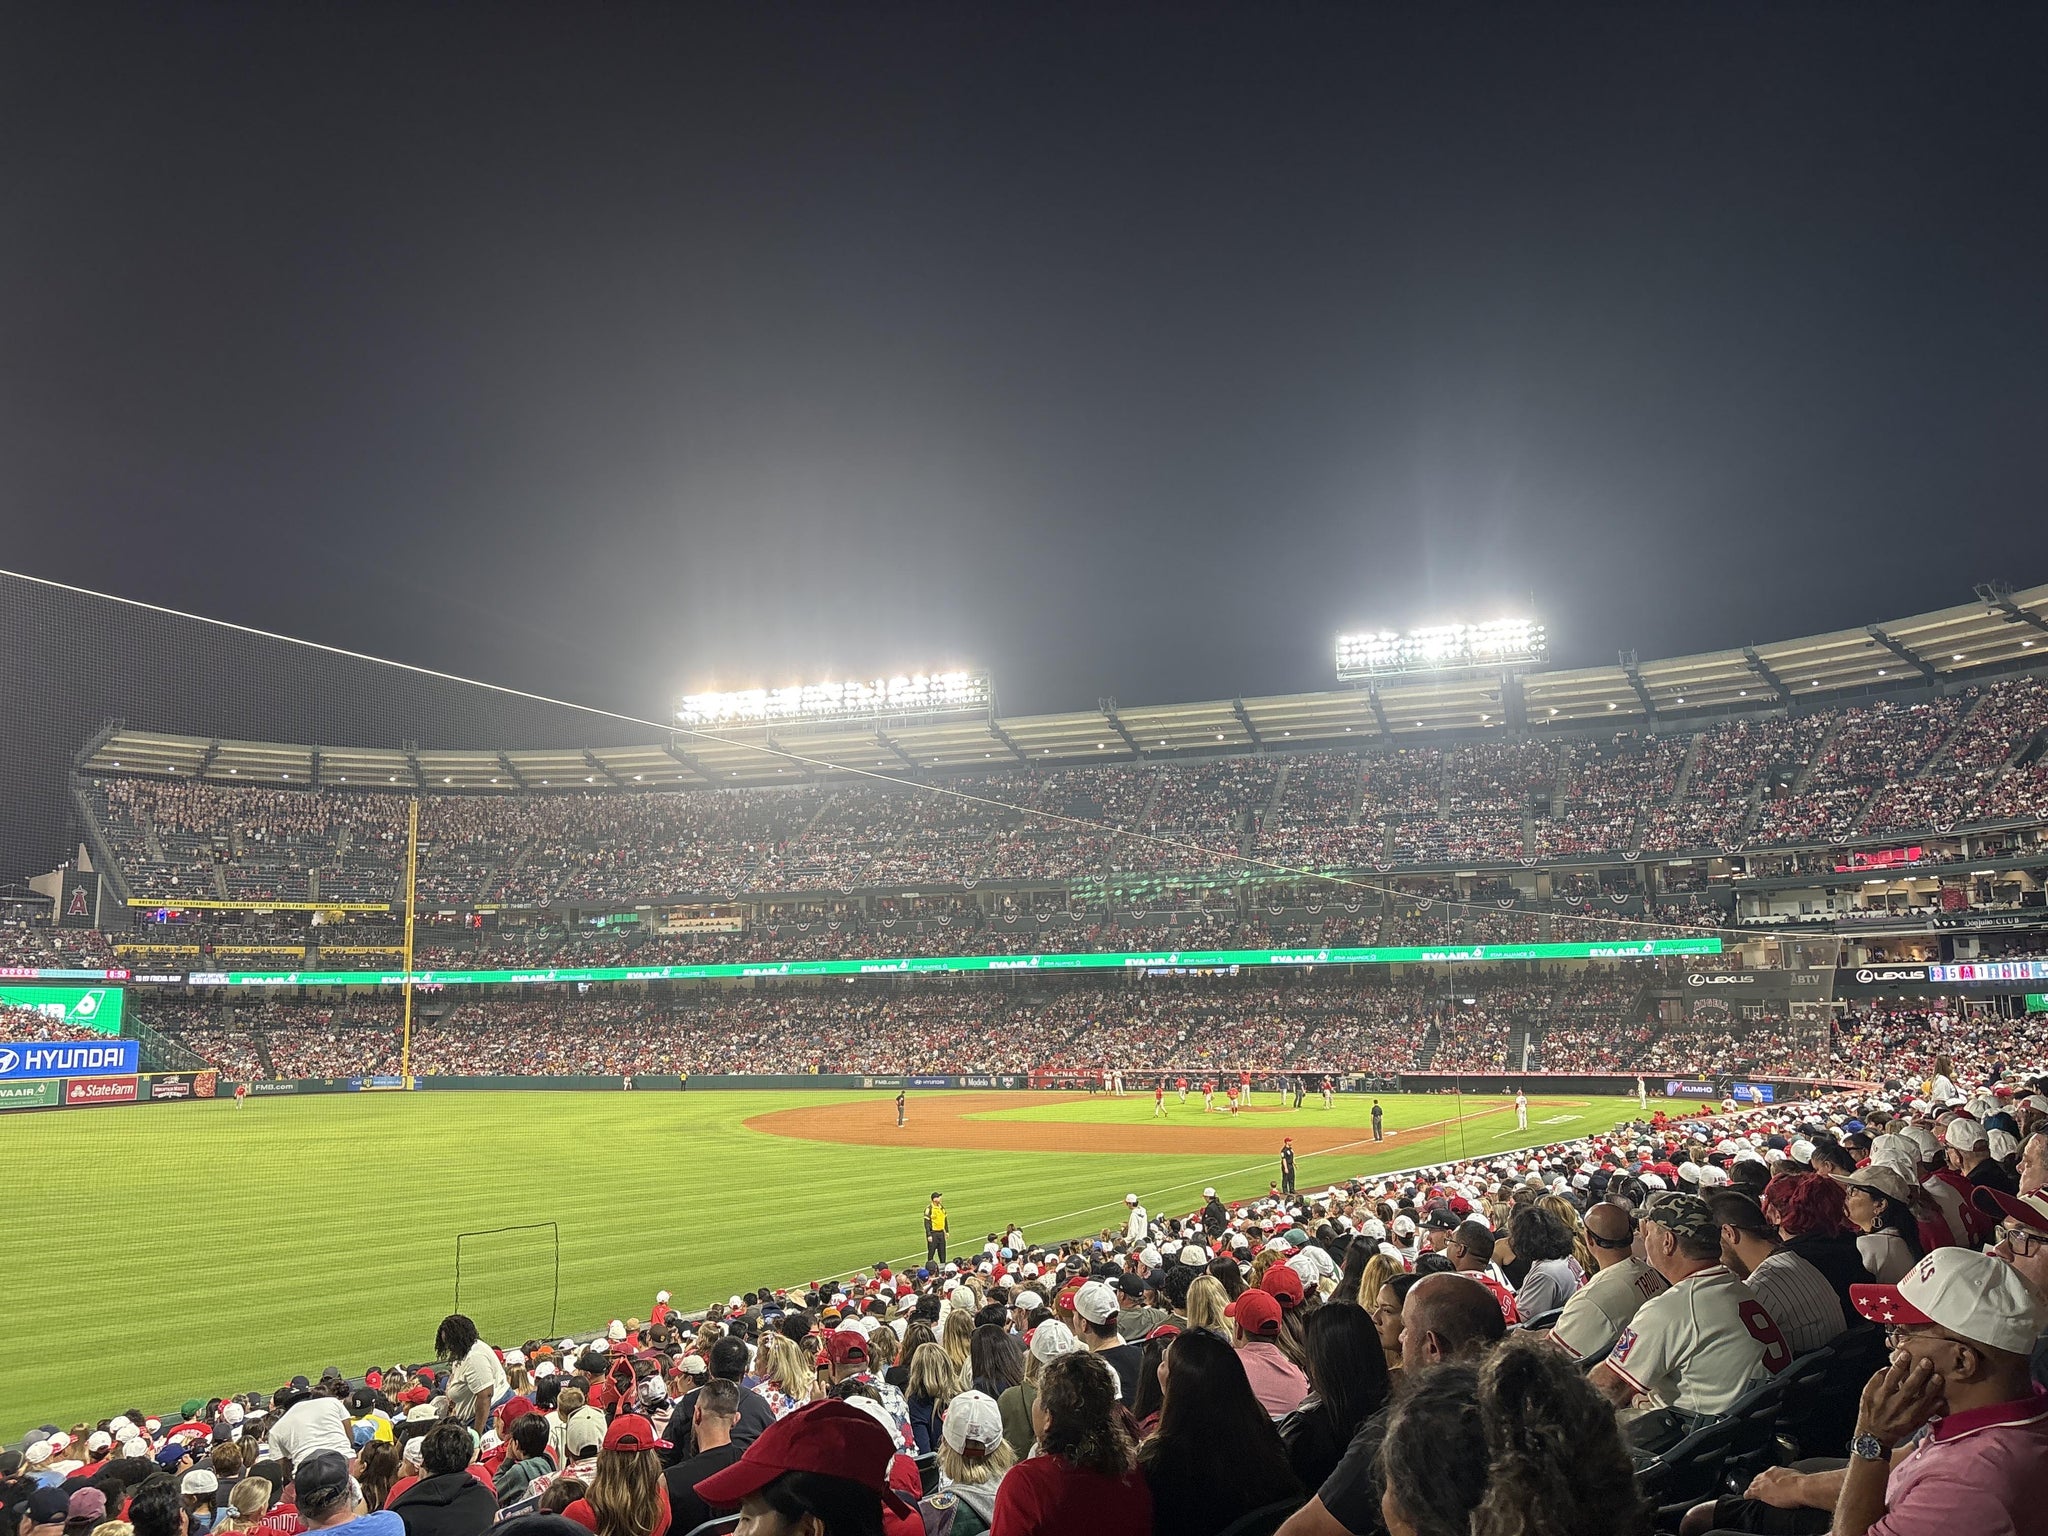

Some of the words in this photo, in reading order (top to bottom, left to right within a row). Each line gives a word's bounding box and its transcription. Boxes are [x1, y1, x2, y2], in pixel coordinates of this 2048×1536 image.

[1996, 917, 2020, 925] CLUB
[109, 970, 127, 979] 8:50
[1874, 971, 1925, 980] LEXUS
[1706, 975, 1755, 984] LEXUS
[25, 1048, 125, 1070] HYUNDAI
[967, 1077, 989, 1087] Modelo
[255, 1083, 294, 1091] FMB.com
[1682, 1085, 1713, 1094] KUMHO
[1737, 1299, 1793, 1375] 9
